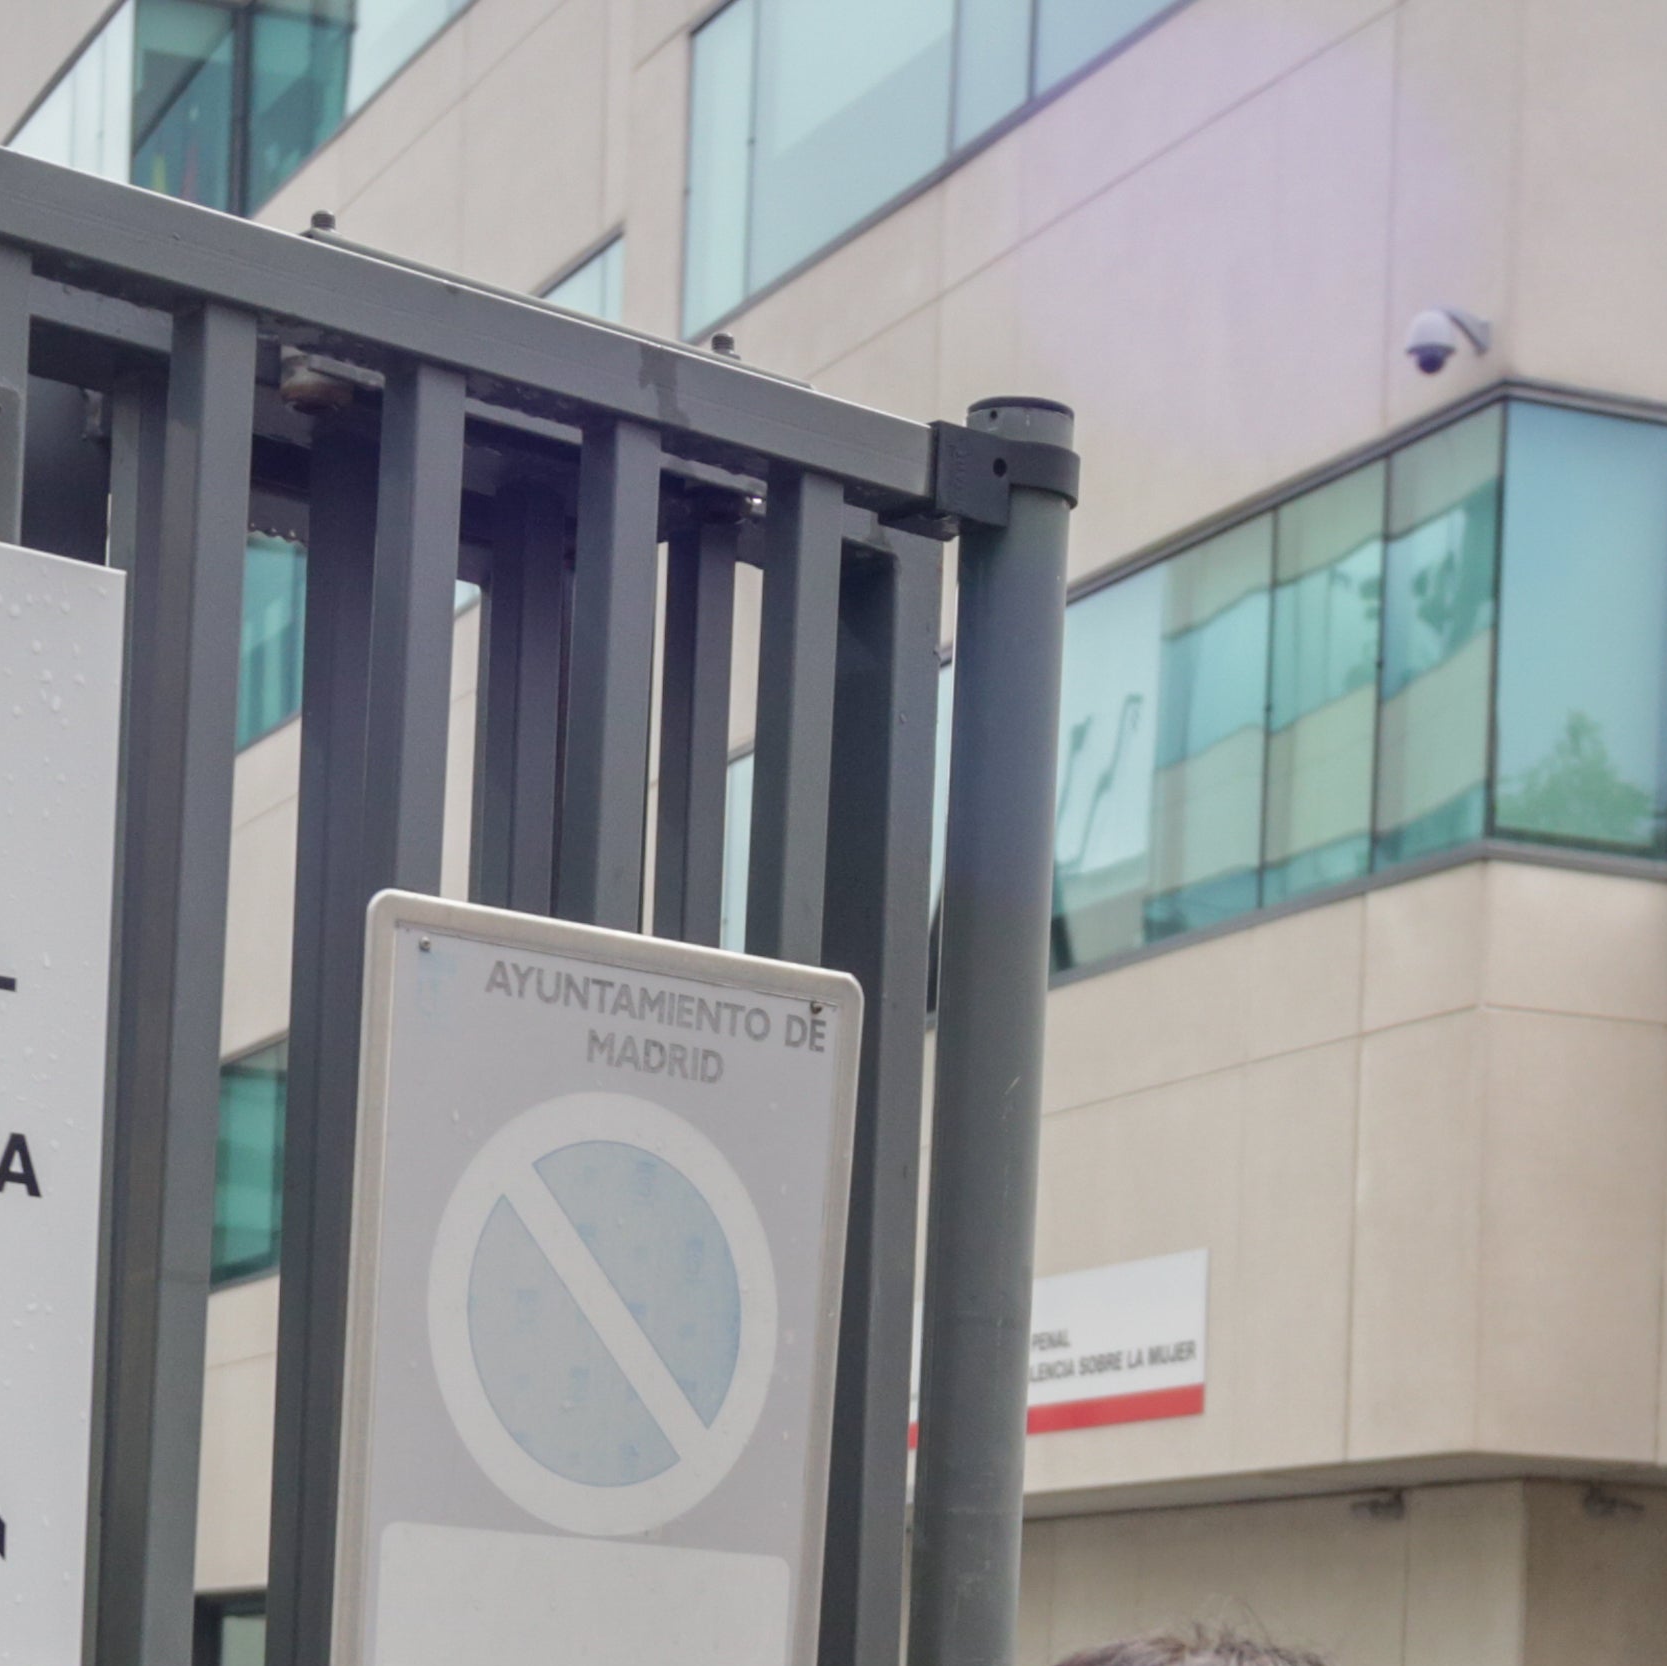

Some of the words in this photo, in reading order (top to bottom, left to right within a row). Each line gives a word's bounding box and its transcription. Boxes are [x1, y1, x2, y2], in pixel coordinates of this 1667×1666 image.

[485, 960, 772, 1042] AYUNTAMIENTO
[784, 1014, 827, 1053] DE
[586, 1029, 725, 1084] MADRID
[1032, 1329, 1070, 1351] PENAL
[1079, 1350, 1123, 1376] SOBRE
[1127, 1347, 1144, 1370] LA
[1147, 1340, 1196, 1367] MUJER
